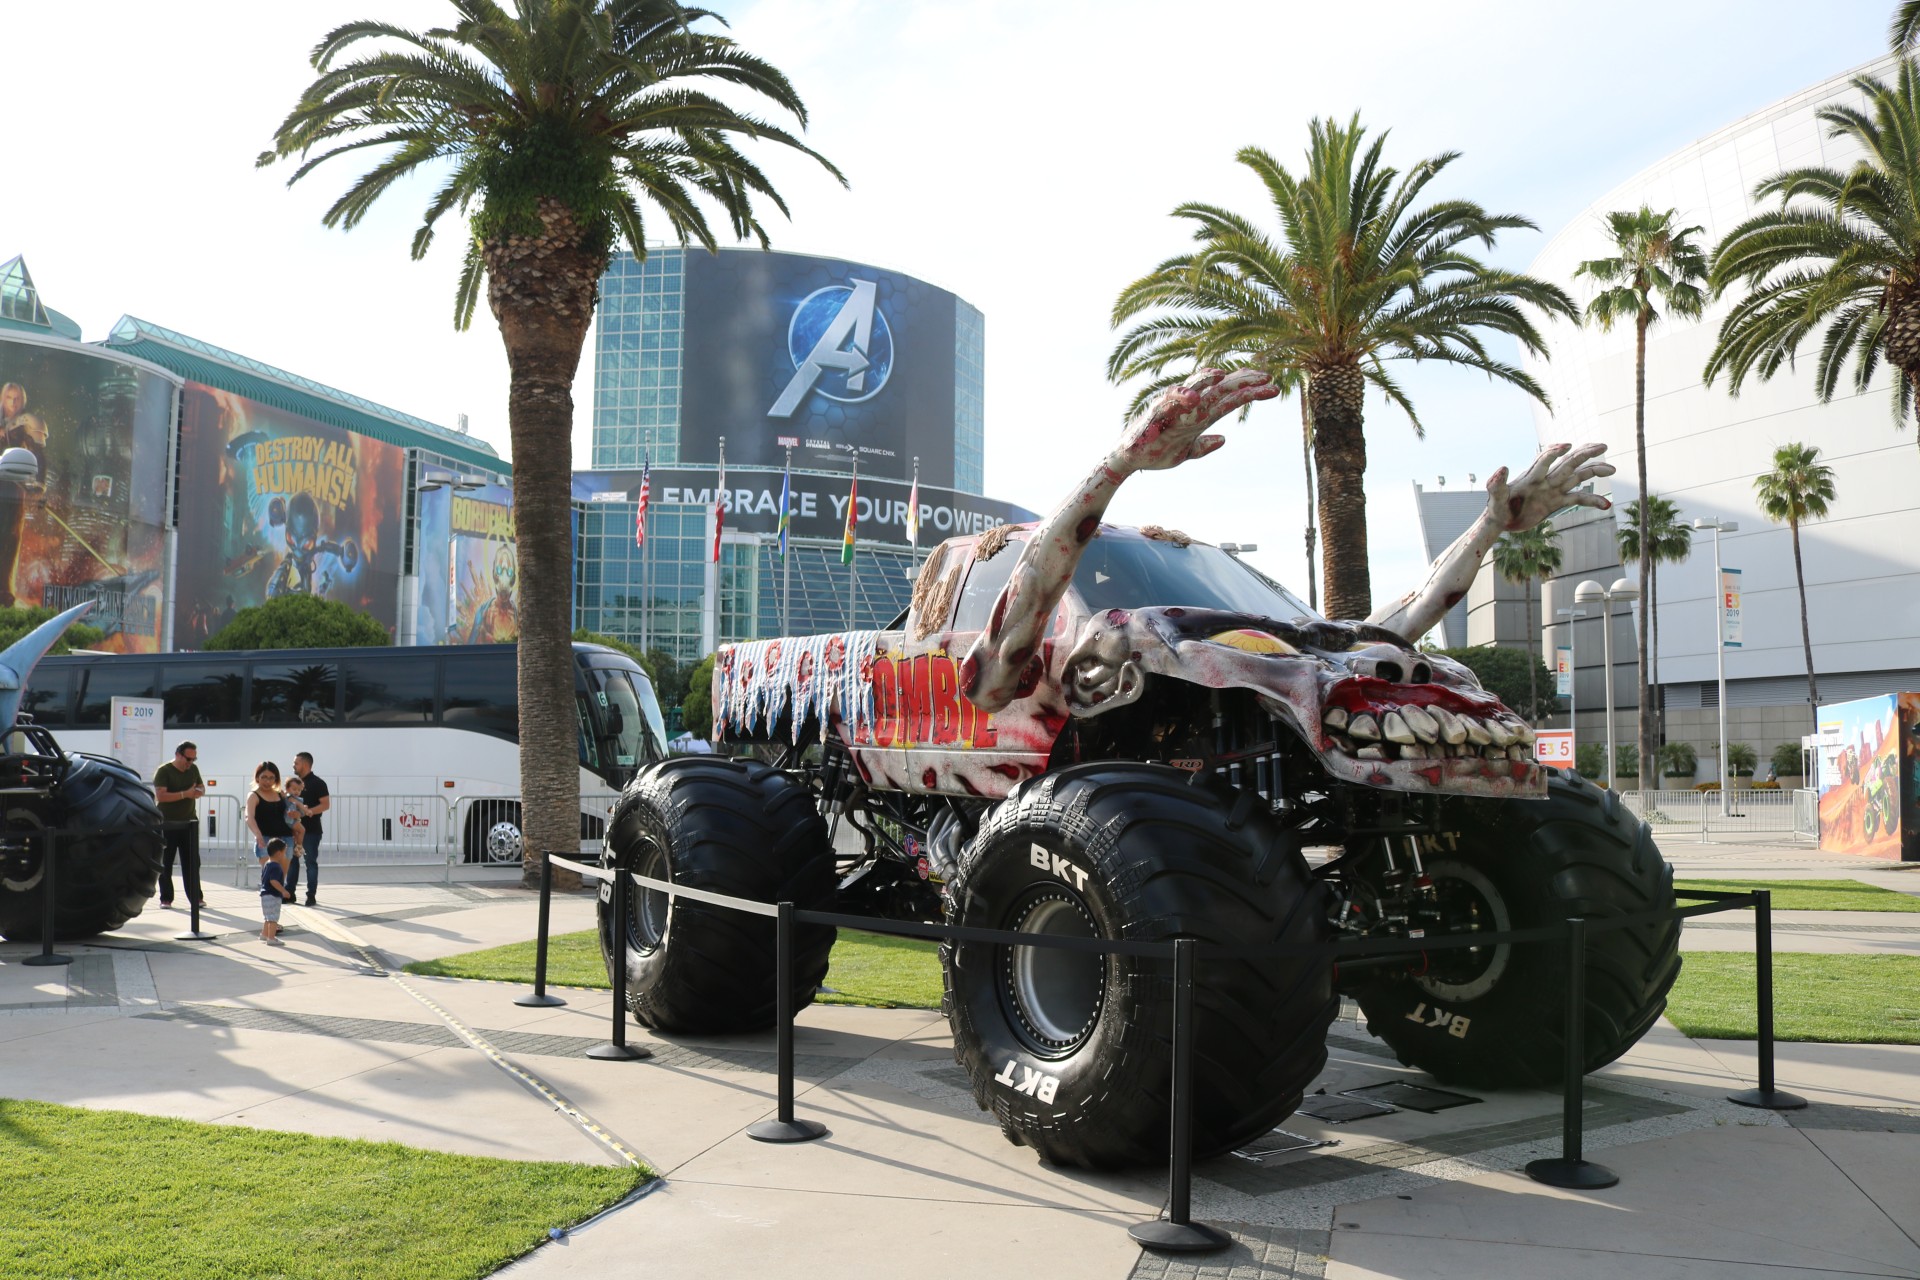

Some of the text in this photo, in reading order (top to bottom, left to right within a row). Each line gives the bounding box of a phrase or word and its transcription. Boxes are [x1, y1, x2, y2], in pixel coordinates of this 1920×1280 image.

[778, 436, 799, 447] MARVEL
[859, 446, 882, 455] SQUARE
[255, 436, 354, 476] DESTROY ALL
[253, 462, 353, 511] HUMANS!
[452, 496, 516, 538] BORDERLA
[663, 487, 818, 518] EMBRACE
[829, 494, 908, 526] YOUR
[1725, 592, 1740, 609] E3
[1726, 609, 1740, 617] 2019
[1559, 662, 1569, 673] E3
[122, 706, 154, 717] E3 2019
[600, 692, 607, 704] 6
[855, 654, 998, 748] OMBI
[1538, 741, 1570, 757] E3 5
[1031, 842, 1089, 892] BKT
[1405, 1002, 1471, 1039] BKT
[994, 1060, 1060, 1105] BKT
